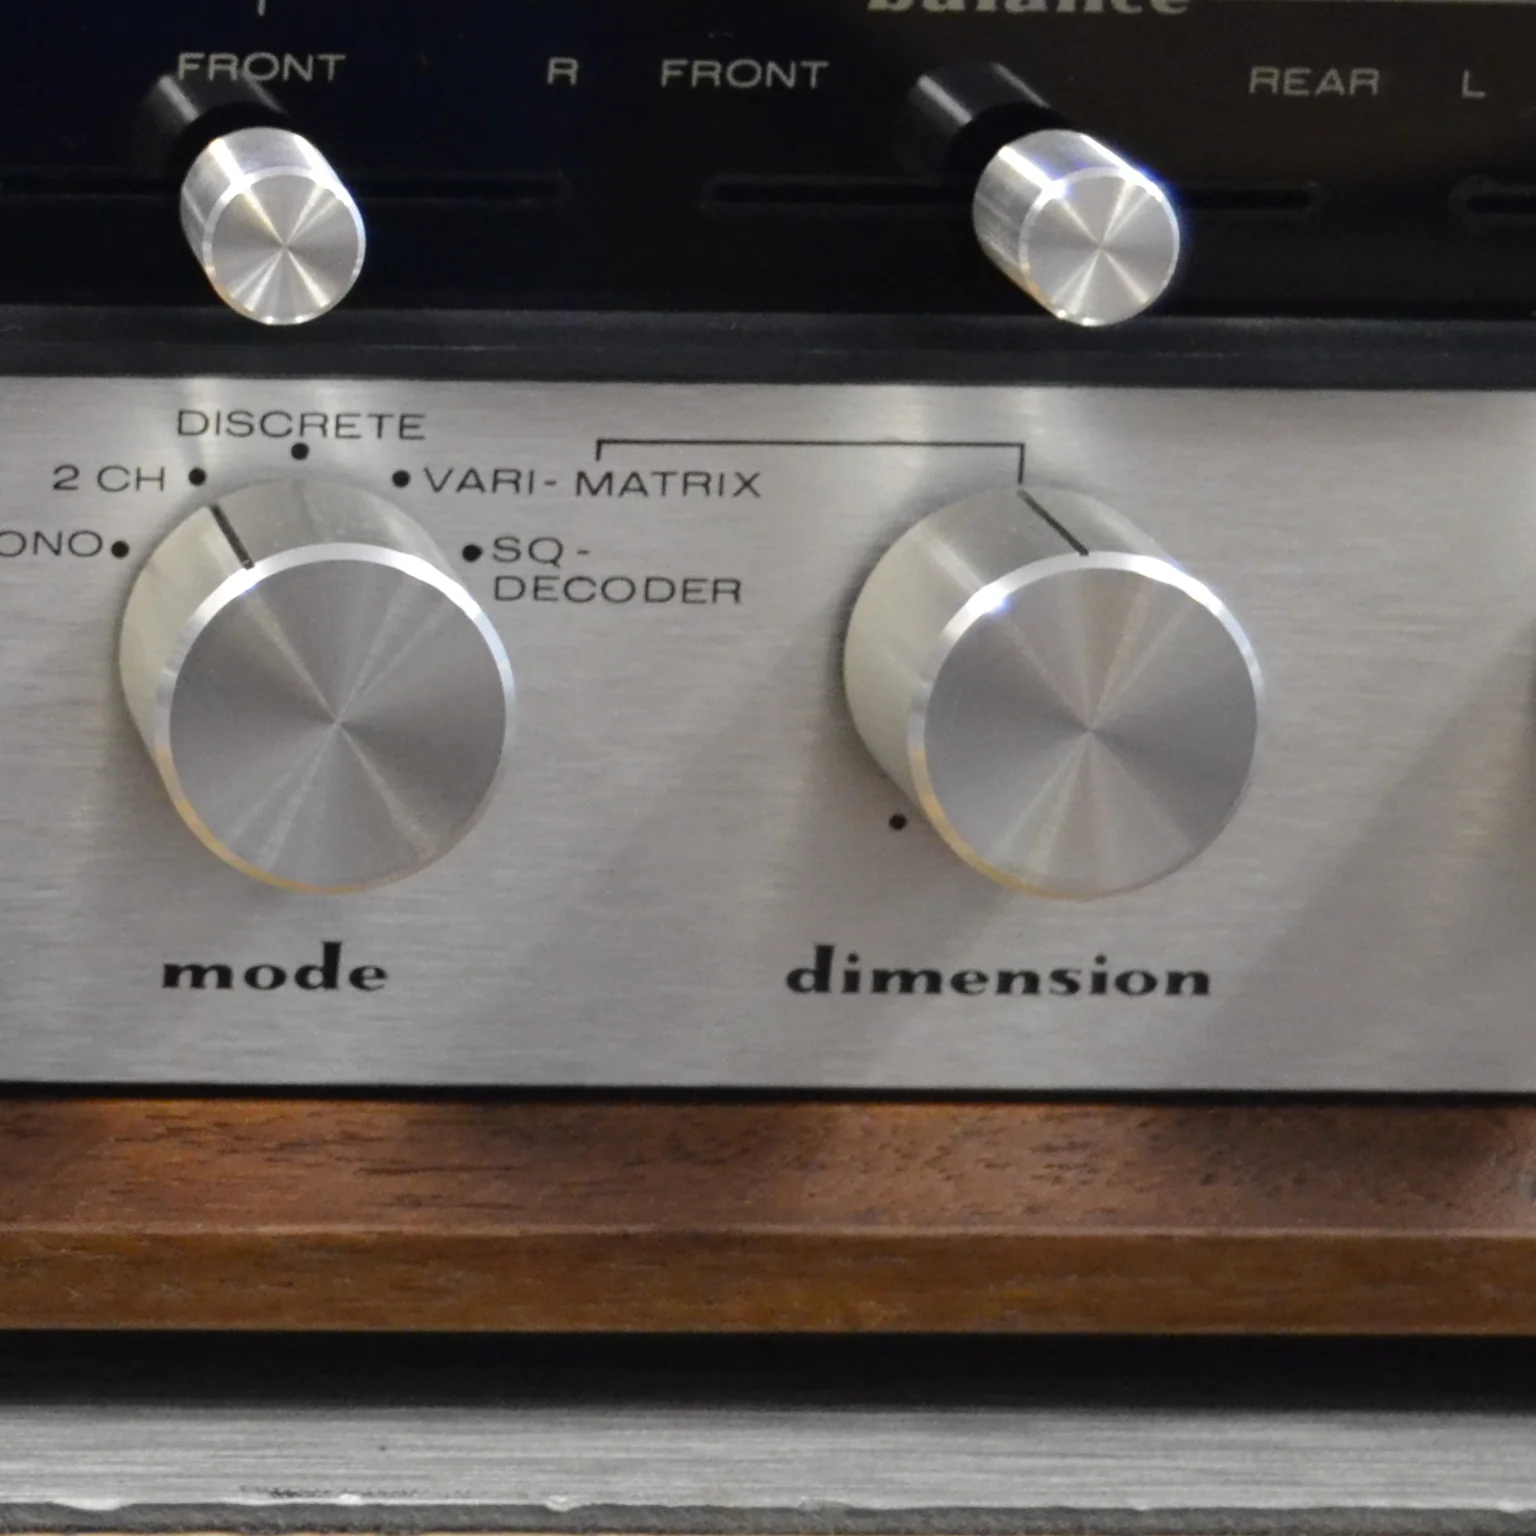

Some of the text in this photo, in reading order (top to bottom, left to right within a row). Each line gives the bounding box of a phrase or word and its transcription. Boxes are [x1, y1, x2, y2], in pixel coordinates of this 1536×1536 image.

[177, 52, 346, 82] FRONT
[547, 57, 578, 85] R
[660, 60, 830, 89] FRONT
[1248, 67, 1379, 97] REAR
[1461, 68, 1488, 98] L
[177, 410, 427, 441] DISCRETE
[52, 465, 167, 493] 2 CH
[494, 575, 743, 604] DECODER
[161, 941, 389, 992] mode
[785, 944, 1211, 996] dimension
